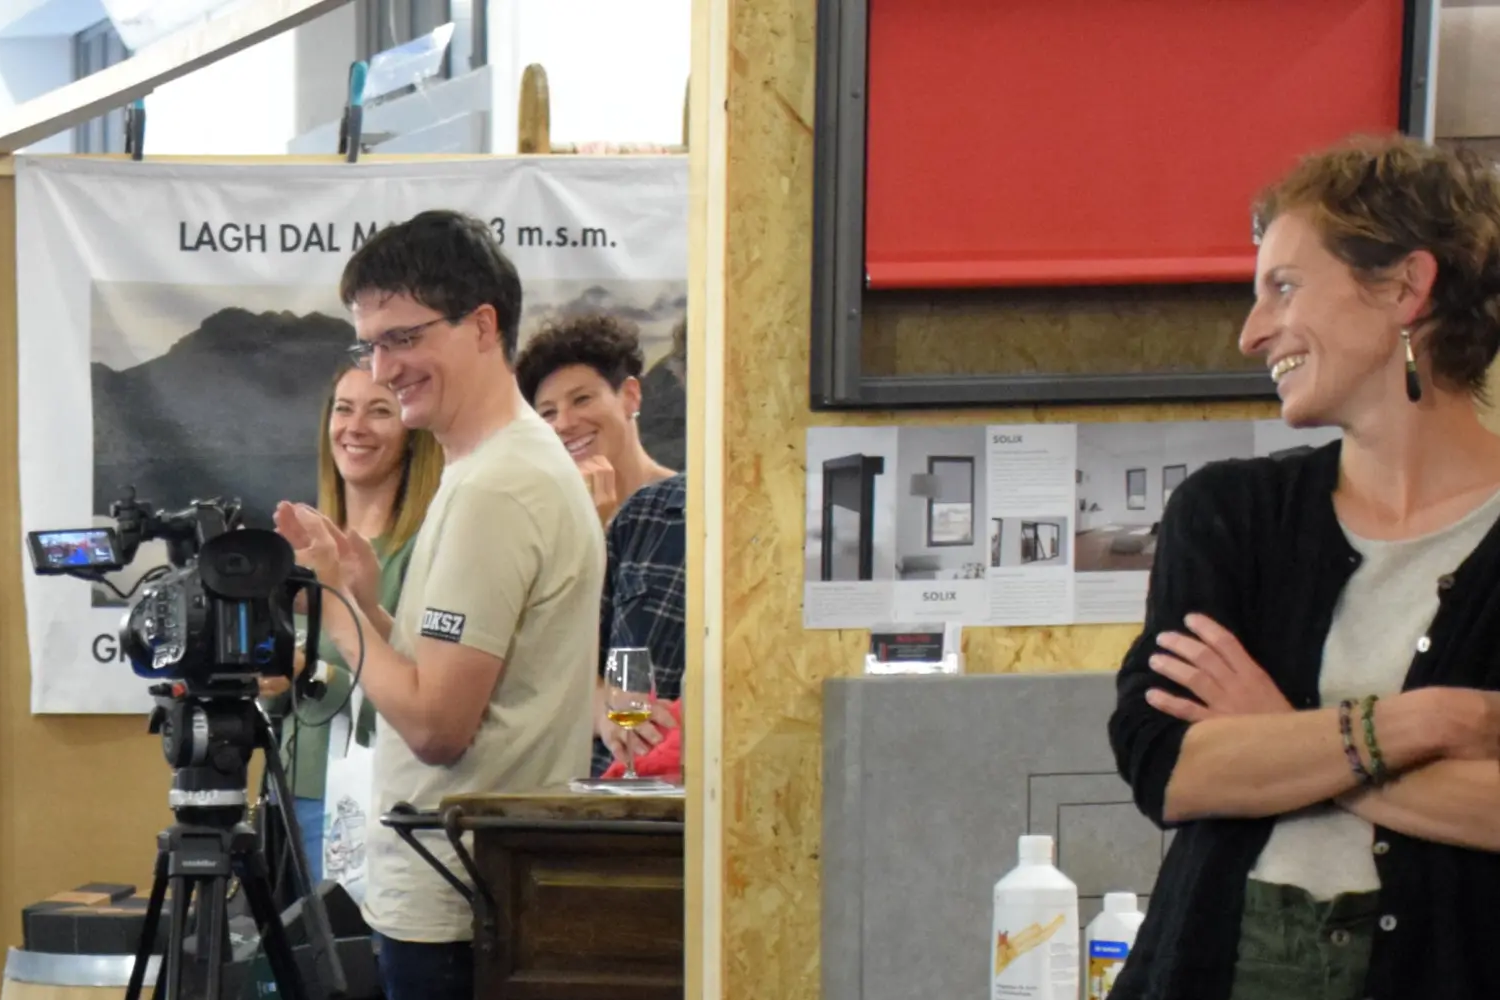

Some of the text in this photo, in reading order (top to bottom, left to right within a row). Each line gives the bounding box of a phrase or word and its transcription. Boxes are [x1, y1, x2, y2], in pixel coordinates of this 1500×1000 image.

[179, 221, 267, 253] LAGH
[279, 222, 341, 253] DAL
[517, 226, 617, 248] m.s.m.
[992, 434, 1023, 444] SOLIX
[922, 591, 957, 602] SOLIX
